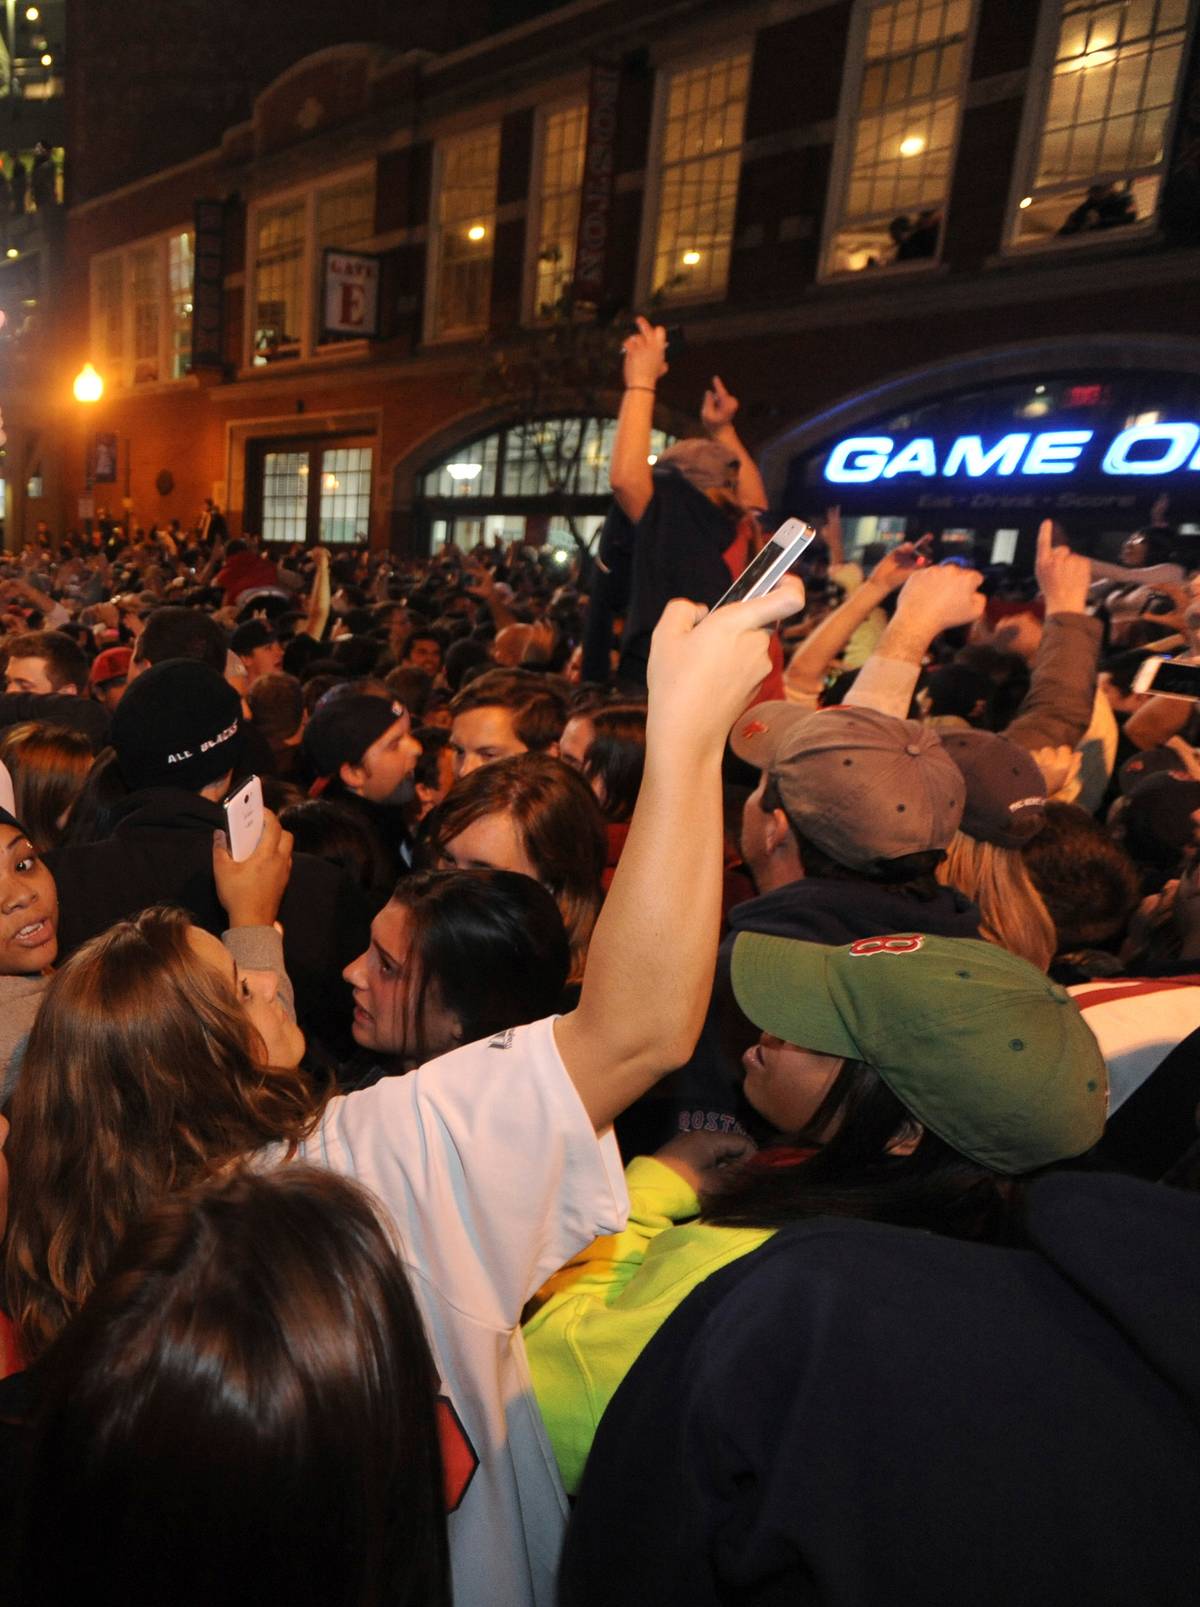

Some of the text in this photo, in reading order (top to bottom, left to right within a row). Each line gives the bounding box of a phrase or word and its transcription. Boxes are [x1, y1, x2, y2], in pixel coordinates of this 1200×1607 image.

[578, 71, 621, 284] BOSTON
[339, 283, 365, 326] E
[824, 422, 1200, 483] GAME O
[167, 750, 194, 764] ALL
[848, 933, 926, 957] B
